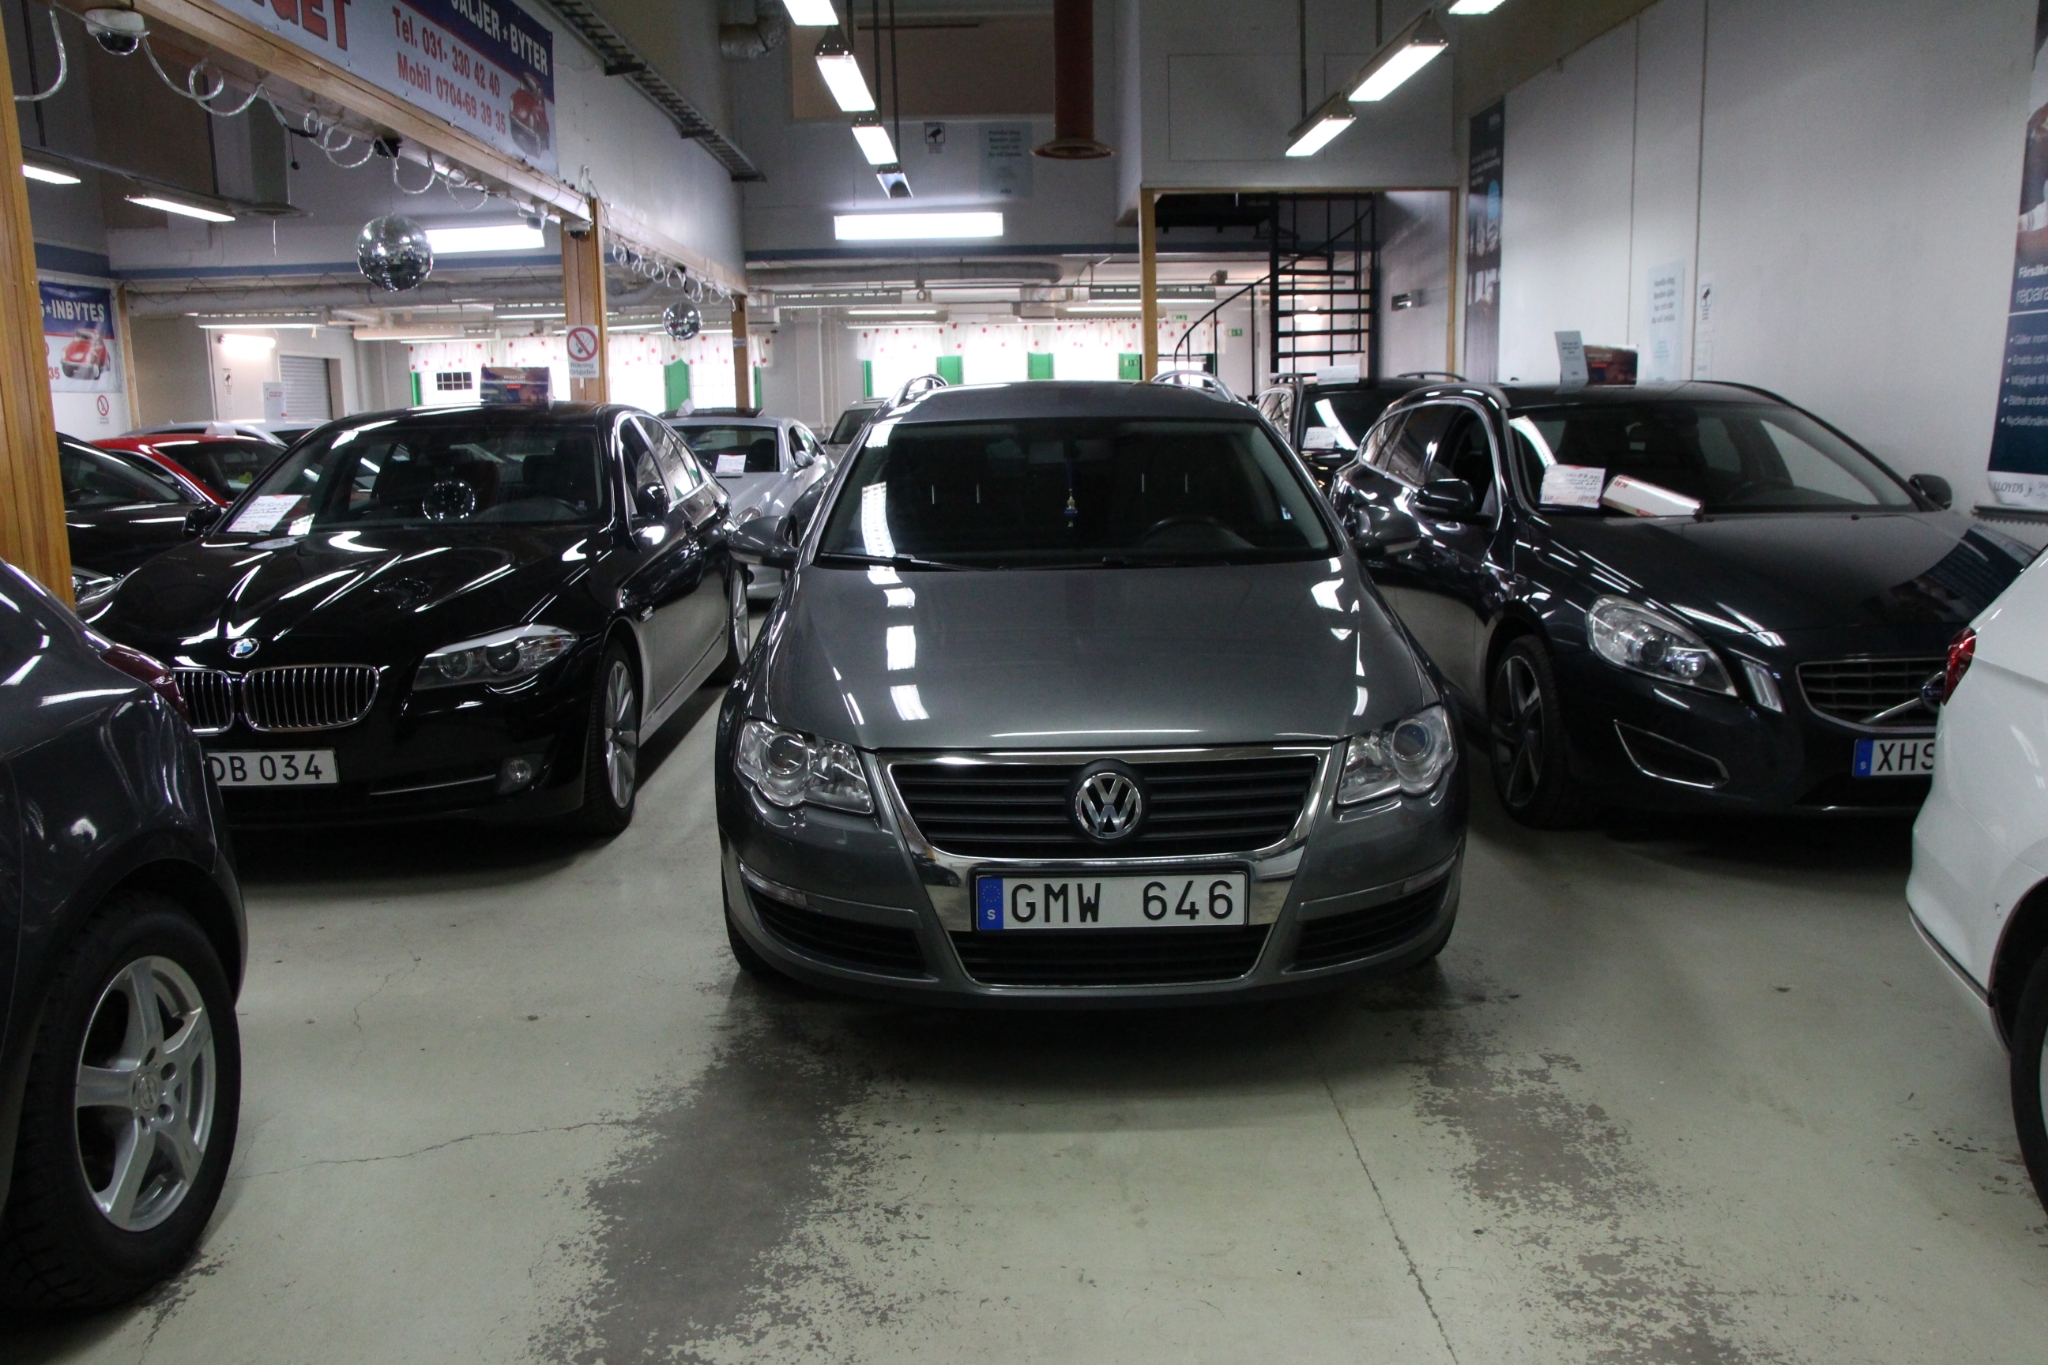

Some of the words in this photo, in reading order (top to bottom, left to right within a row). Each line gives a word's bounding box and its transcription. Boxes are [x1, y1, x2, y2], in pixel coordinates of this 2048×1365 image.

[392, 6, 418, 47] Tel.
[452, 45, 470, 79] 330
[474, 61, 486, 90] 42
[489, 72, 500, 98] 40
[510, 23, 548, 76] BYTER
[397, 52, 432, 94] Mobil
[436, 75, 477, 119] 0704-69
[481, 102, 492, 127] 39
[495, 109, 506, 135] 35
[51, 299, 105, 322] INBYTES
[260, 754, 323, 781] 034
[1860, 761, 1867, 770] S
[1877, 742, 1935, 771] XHS
[987, 909, 996, 920] S
[1011, 883, 1101, 923] GMW
[1142, 880, 1233, 921] 646
